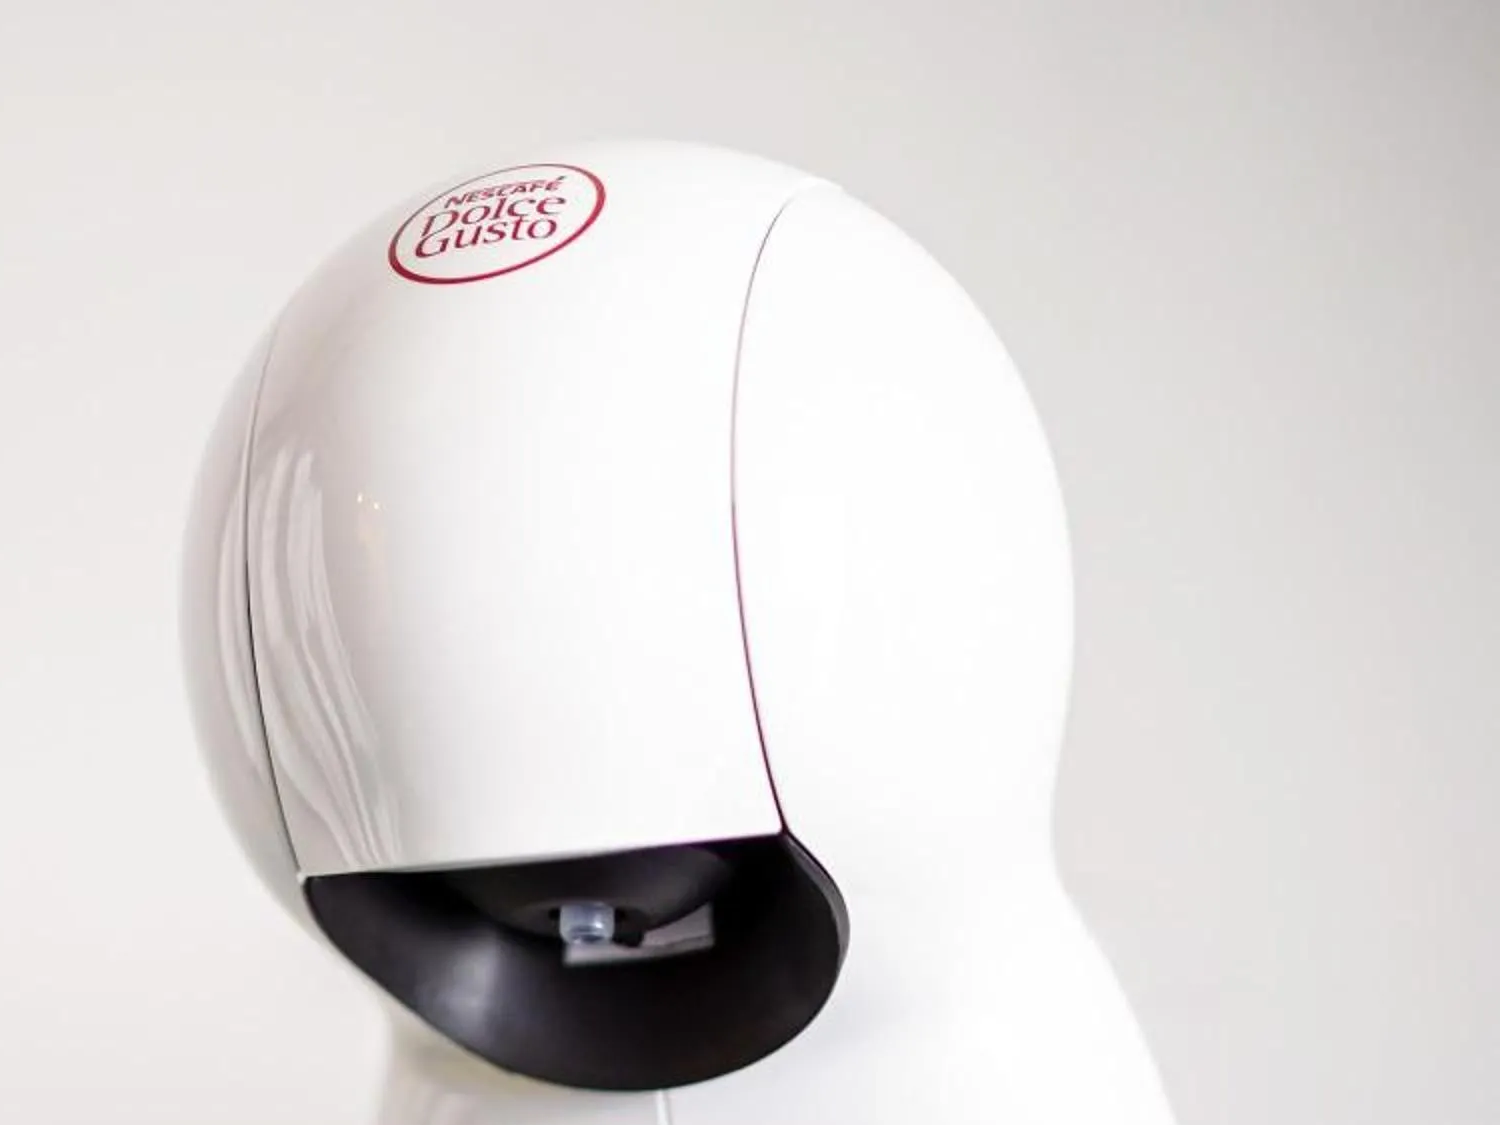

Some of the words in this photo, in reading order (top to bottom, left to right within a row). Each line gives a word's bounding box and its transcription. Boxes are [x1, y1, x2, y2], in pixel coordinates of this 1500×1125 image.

[444, 175, 566, 209] NESCAFÉ
[415, 216, 558, 258] Gusto
[420, 196, 567, 237] Dolce
